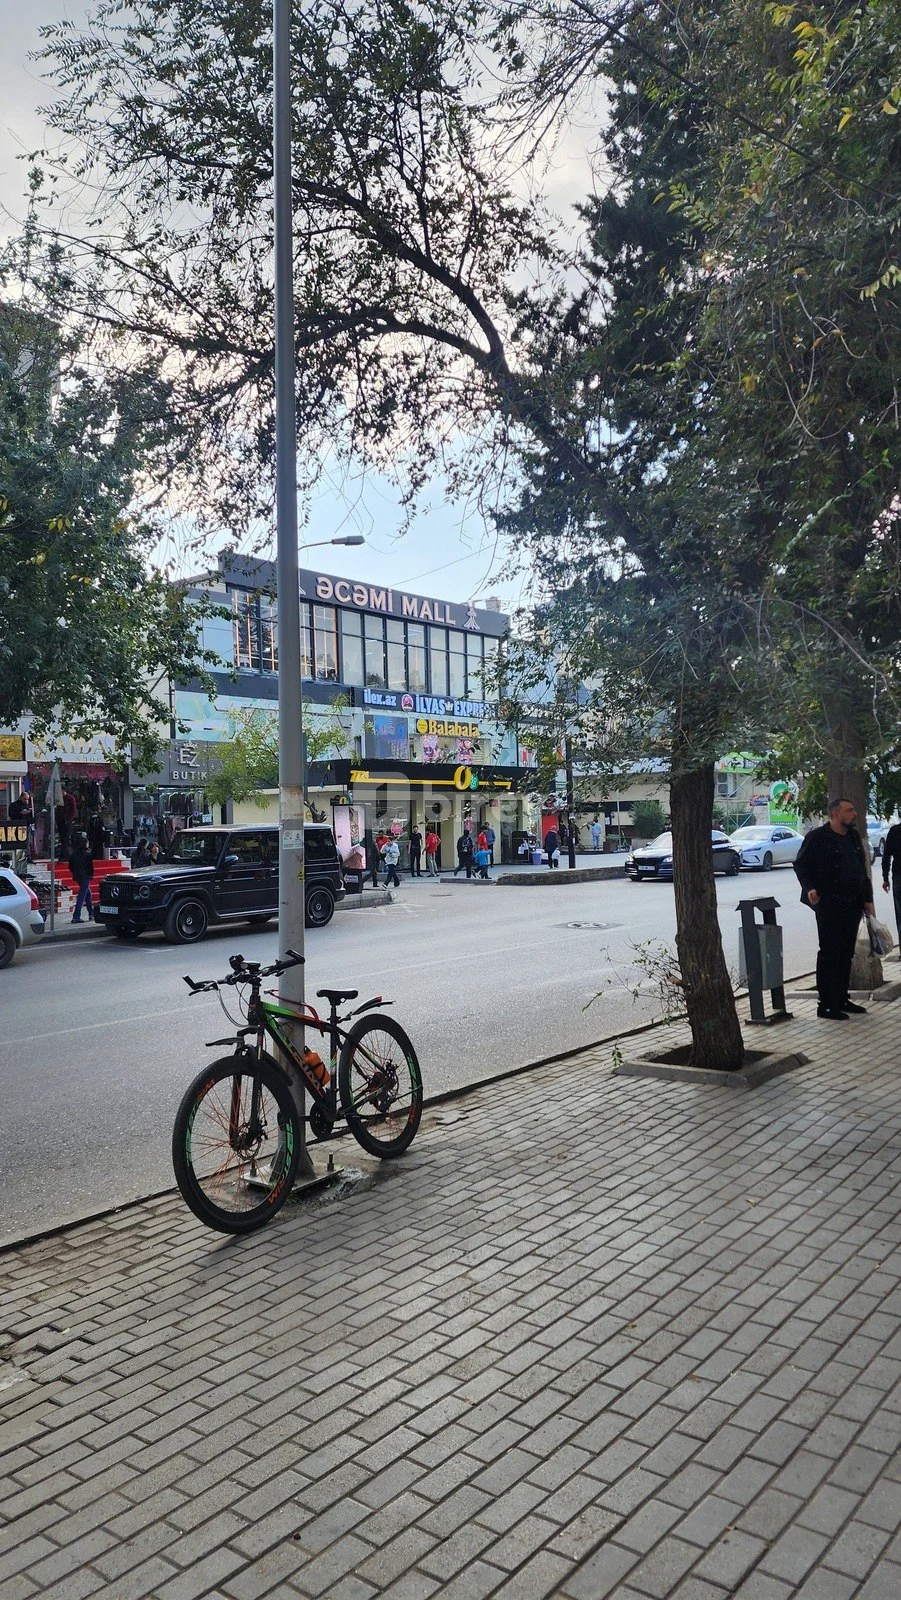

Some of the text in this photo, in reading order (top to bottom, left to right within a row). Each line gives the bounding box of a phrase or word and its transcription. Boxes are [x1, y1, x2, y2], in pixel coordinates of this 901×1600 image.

[315, 576, 457, 626] ƏCƏMİ MALL
[363, 688, 398, 707] ilex.az
[415, 694, 447, 716] İLYAS
[428, 719, 480, 738] Balabala
